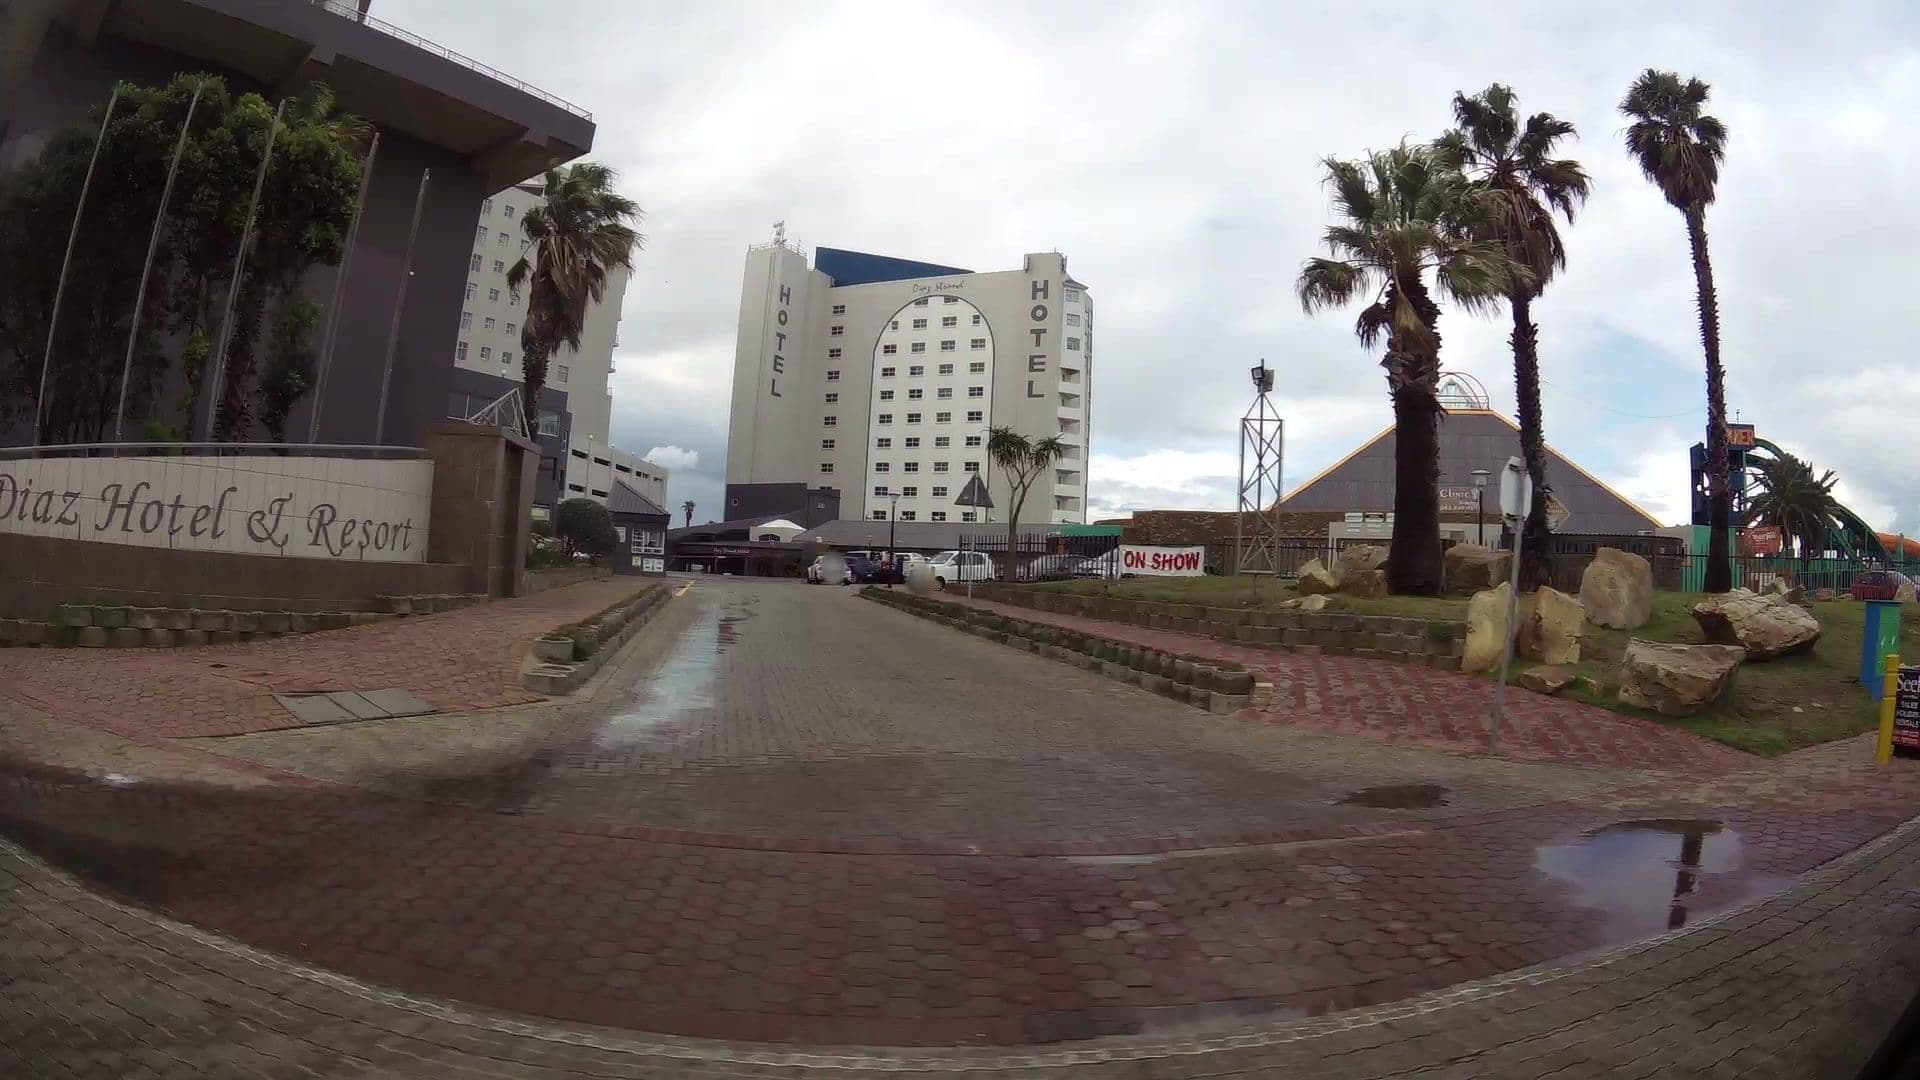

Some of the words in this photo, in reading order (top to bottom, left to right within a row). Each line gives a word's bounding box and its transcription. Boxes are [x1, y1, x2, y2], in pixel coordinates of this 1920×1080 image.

[771, 284, 791, 398] HOTEL
[1027, 279, 1049, 399] HOTEL
[0, 473, 81, 525] Diaz
[95, 481, 238, 540] Hotel
[307, 503, 413, 558] Resort
[1124, 550, 1146, 569] ON
[1150, 551, 1201, 571] SHOW
